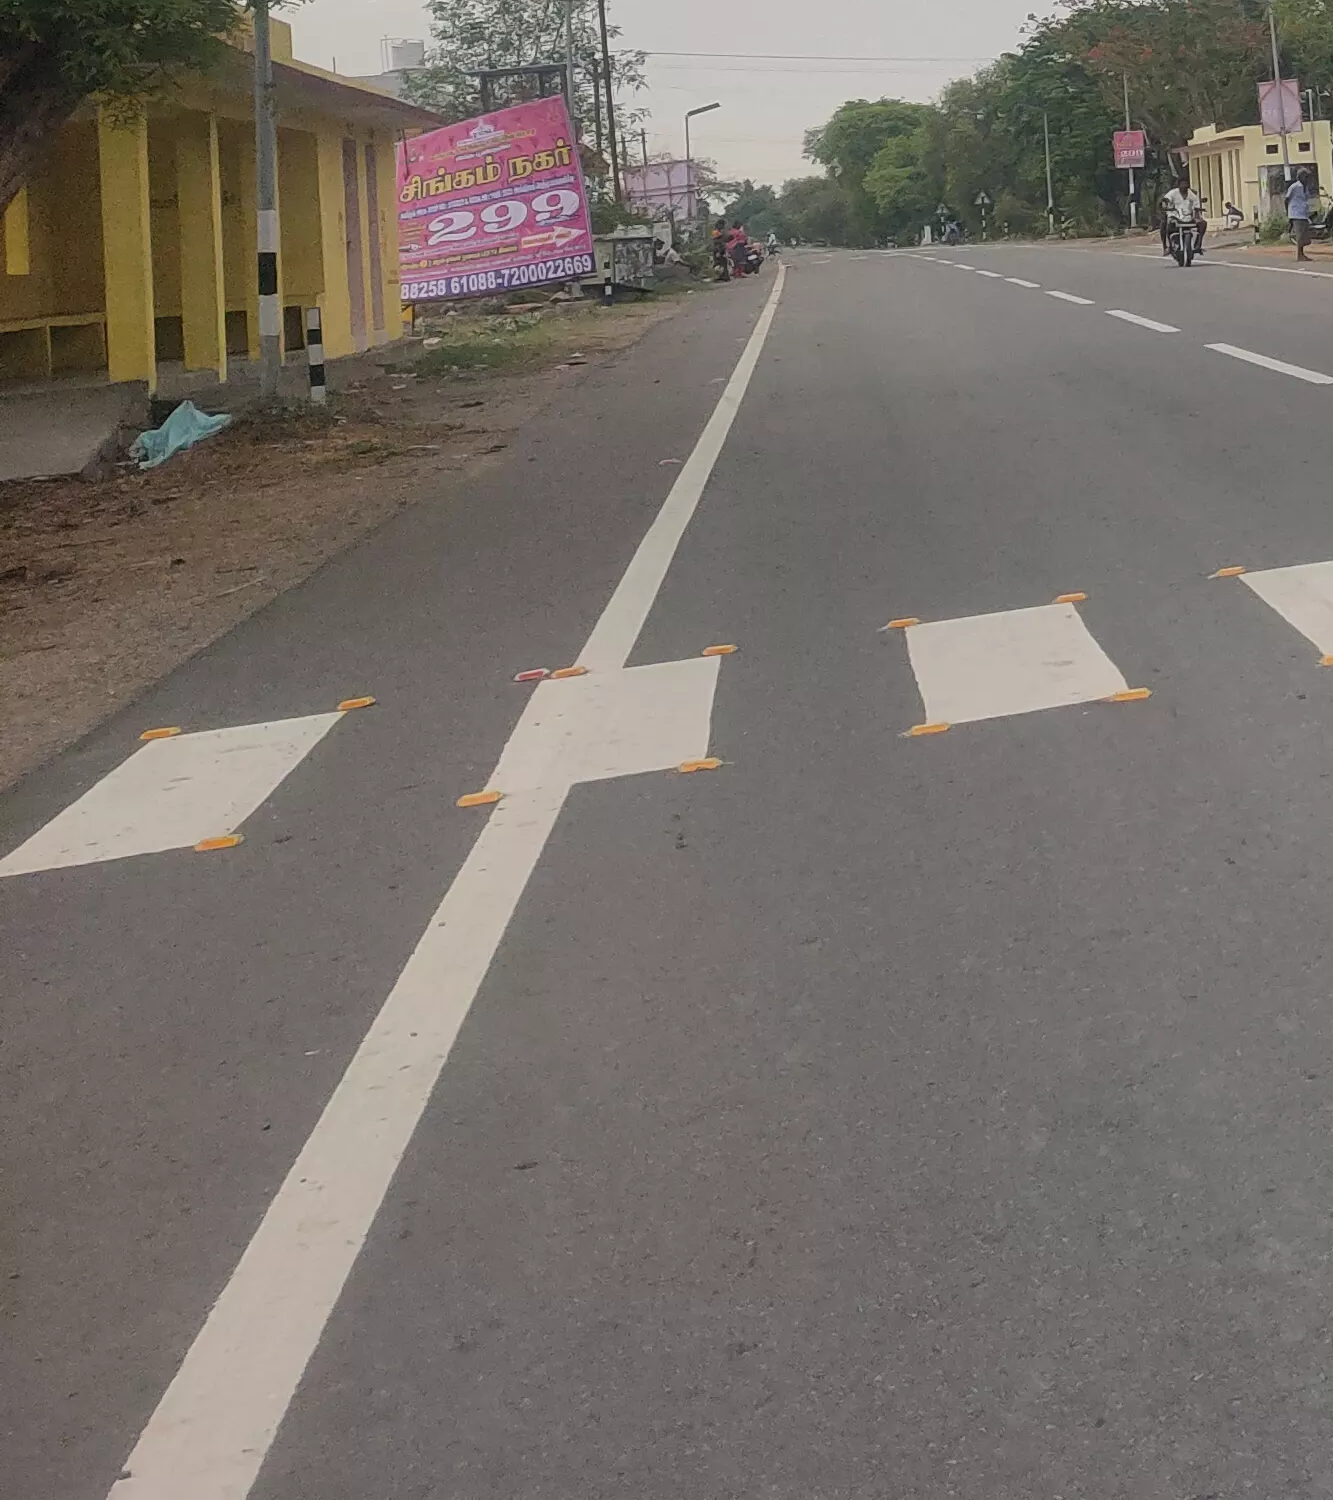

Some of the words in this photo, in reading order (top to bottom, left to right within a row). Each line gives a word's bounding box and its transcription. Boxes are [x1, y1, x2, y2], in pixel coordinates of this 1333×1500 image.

[400, 155, 501, 202] சிங்கம்
[508, 138, 573, 182] நகர்
[428, 189, 580, 245] 299
[400, 279, 446, 300] 88258
